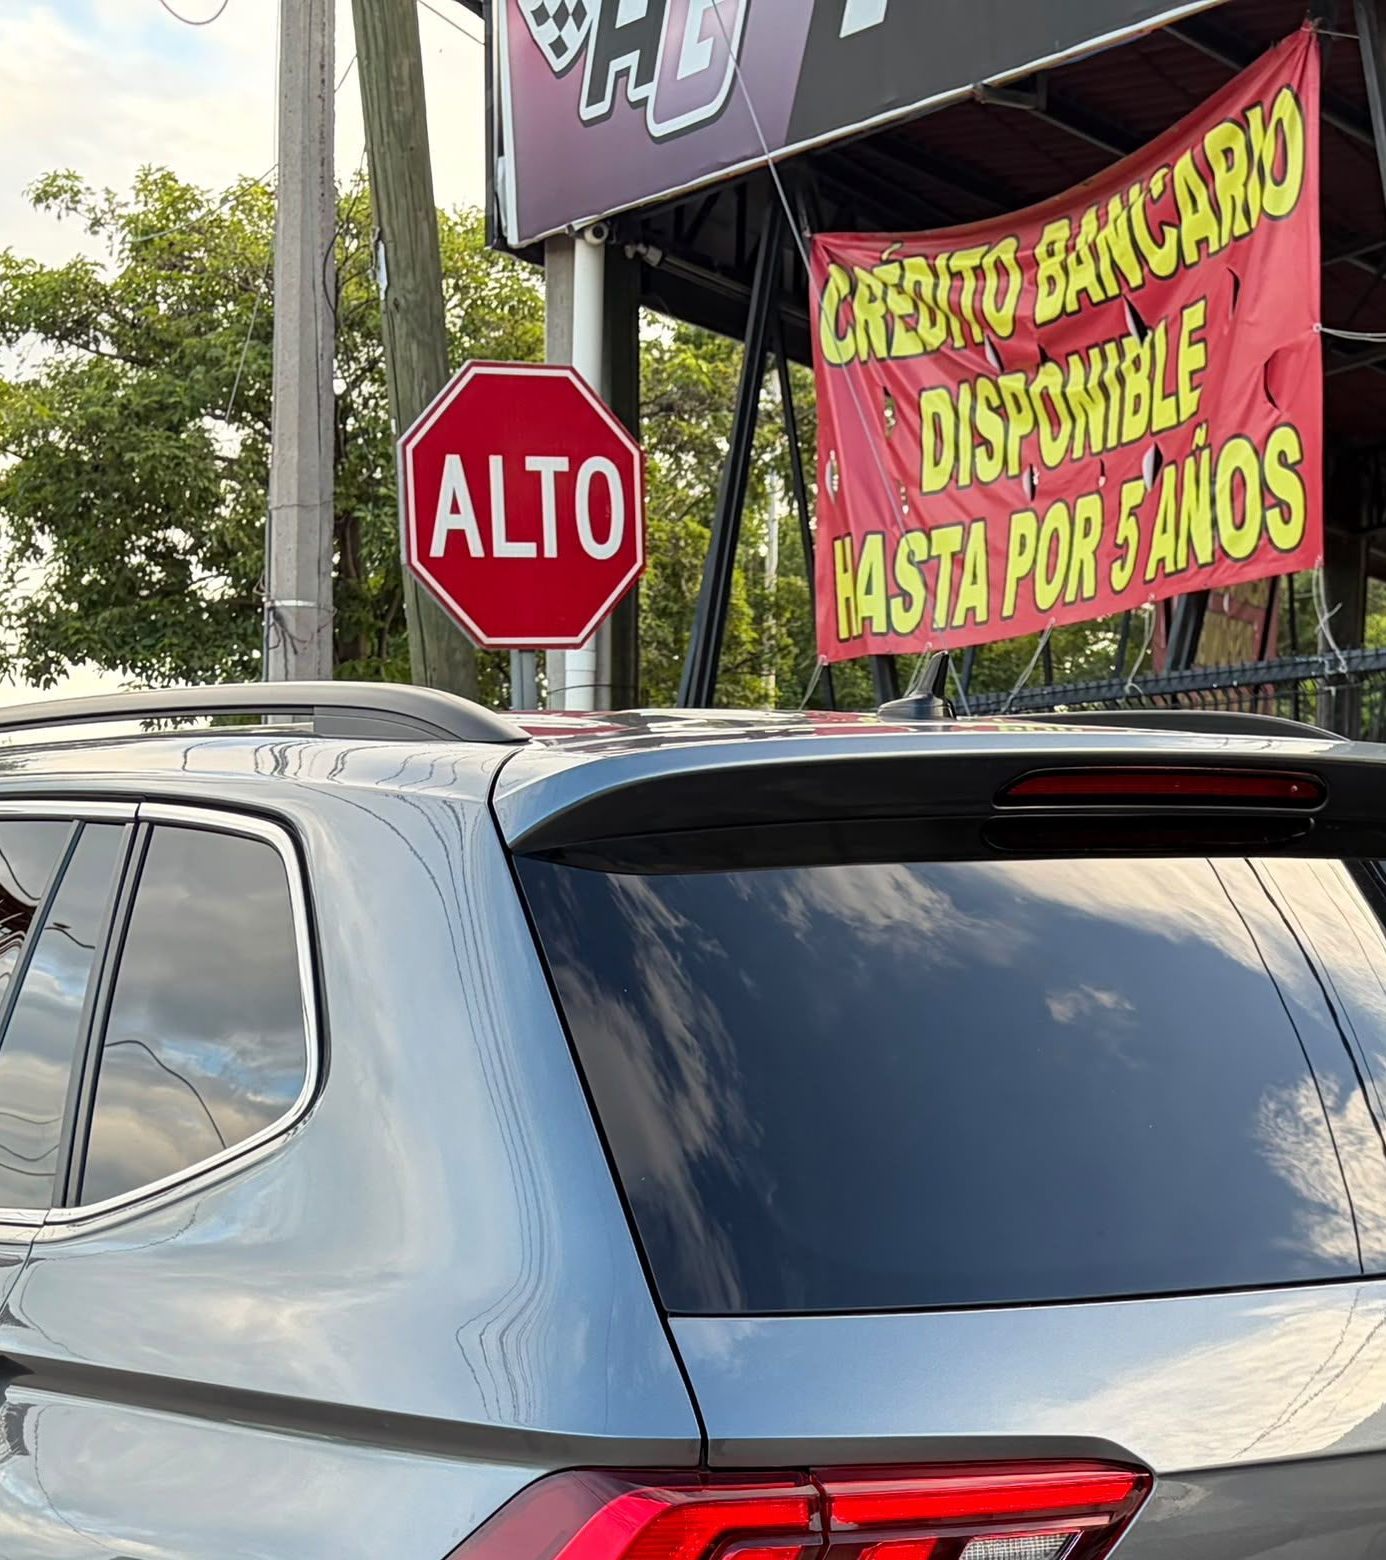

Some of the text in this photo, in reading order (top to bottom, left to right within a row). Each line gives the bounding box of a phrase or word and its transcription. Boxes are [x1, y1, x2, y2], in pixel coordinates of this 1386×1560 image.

[820, 84, 1306, 366] CRÉDITO BANCARIO
[918, 295, 1209, 496] DISPONIBLE
[429, 454, 625, 562] ALTO
[832, 421, 1308, 642] HASTA POR 5 AÑOS
